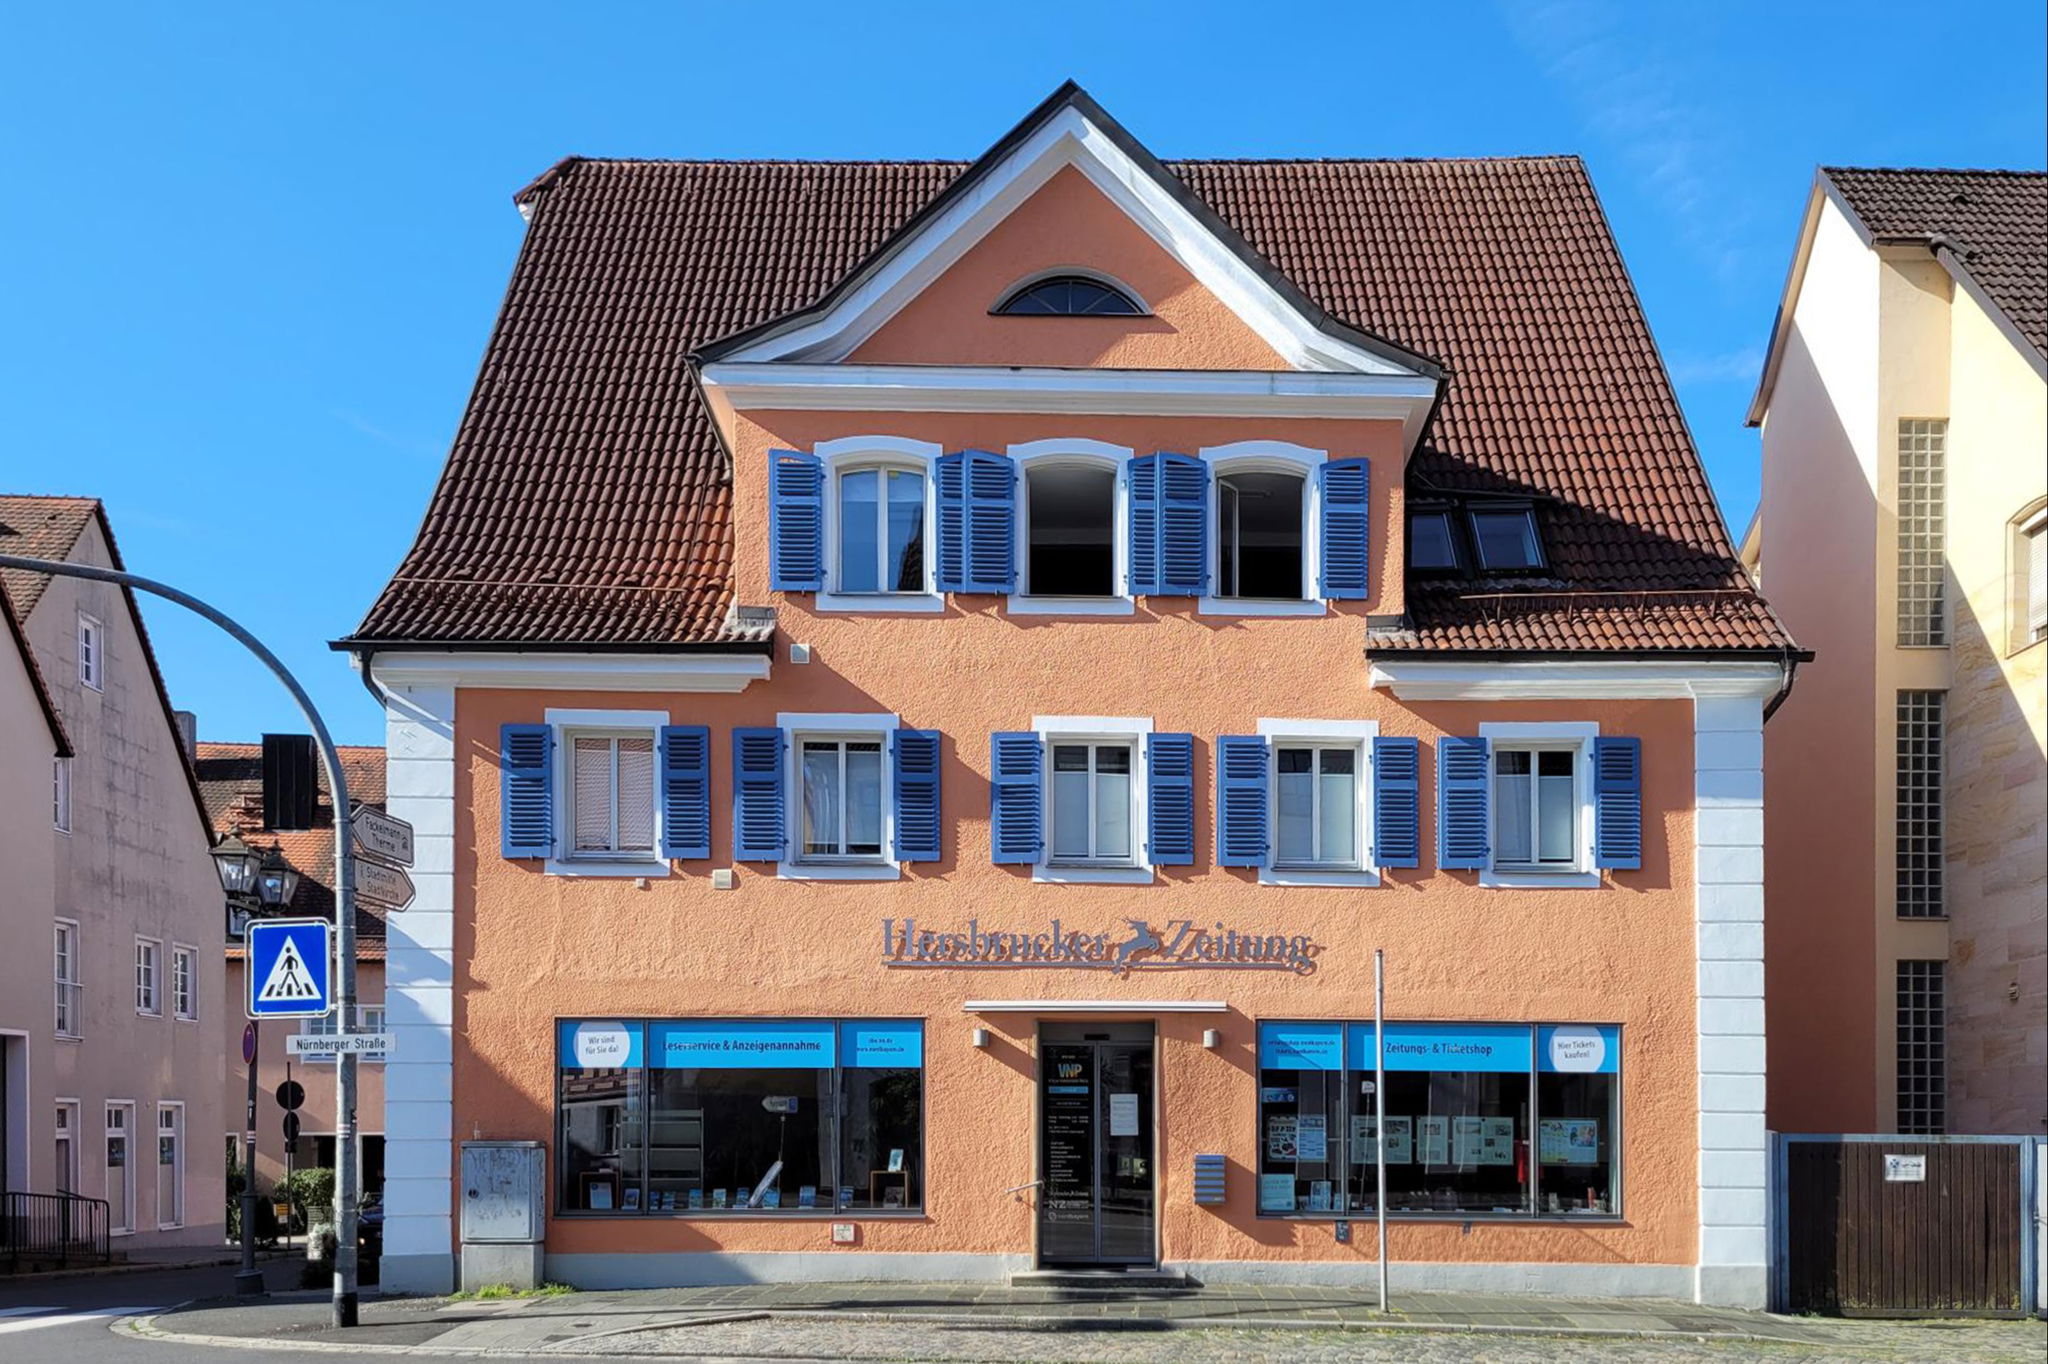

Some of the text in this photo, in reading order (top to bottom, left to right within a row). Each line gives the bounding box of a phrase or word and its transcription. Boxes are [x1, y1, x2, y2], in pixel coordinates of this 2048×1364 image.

[365, 816, 401, 837] Fackelmann
[372, 832, 396, 852] Therme
[881, 918, 1312, 969] Hersbrucker Zeitung
[296, 1037, 386, 1052] Nürnberger Straße
[663, 1039, 821, 1053] Leserservice & Anzeigenannahme
[1386, 1042, 1493, 1056] Zeitungs- & Ticketshop
[1571, 1041, 1595, 1049] Tickets
[1058, 1063, 1082, 1078] VNP
